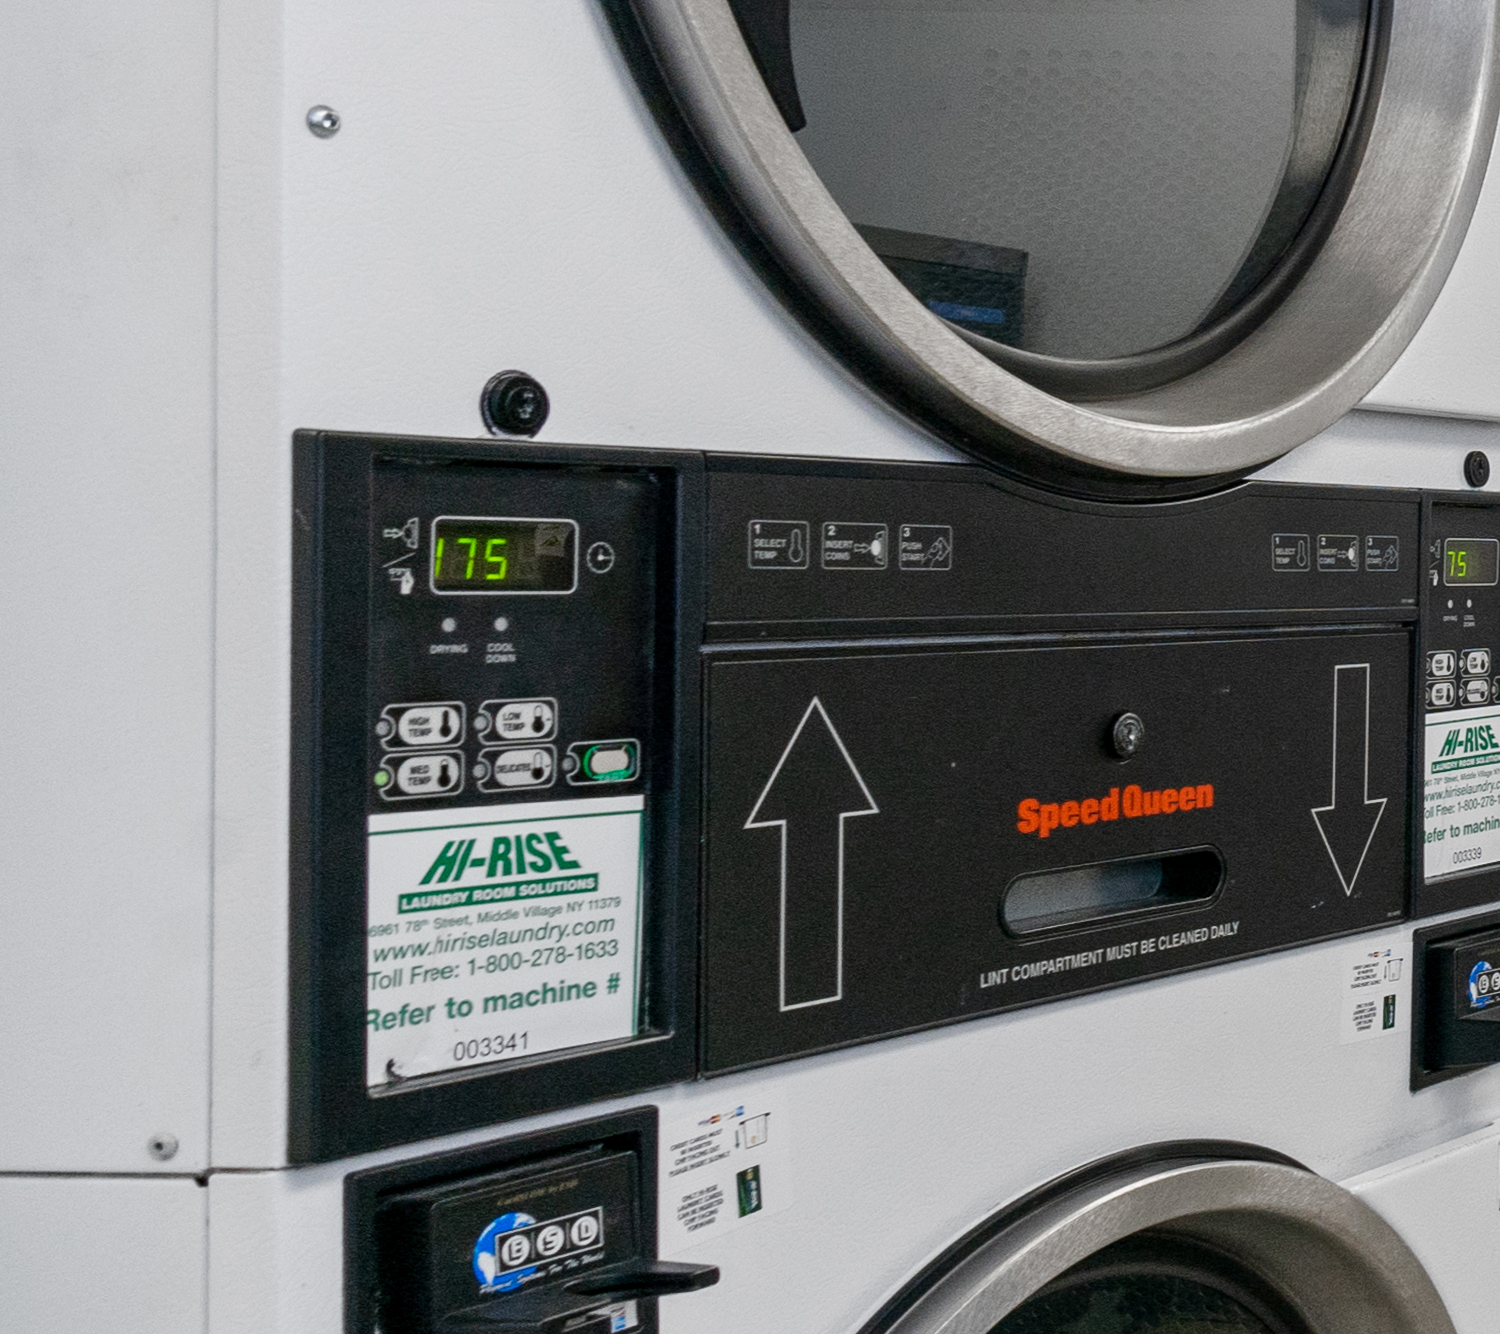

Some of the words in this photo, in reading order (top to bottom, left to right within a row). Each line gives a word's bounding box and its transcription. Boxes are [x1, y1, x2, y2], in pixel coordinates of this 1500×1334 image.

[433, 537, 508, 580] 175
[1447, 551, 1467, 577] 75
[429, 643, 468, 655] DRYING
[486, 642, 515, 653] COOL
[485, 653, 517, 664] DOWN
[407, 717, 430, 727] HIGH
[502, 711, 522, 722] LOW
[408, 727, 432, 739] TEMP
[502, 721, 526, 732] TEMP
[1438, 724, 1500, 757] HI-RISE
[407, 775, 432, 787] TEMP
[409, 765, 430, 776] MED
[1017, 786, 1121, 839] Speed
[1122, 783, 1215, 818] Queen
[418, 831, 583, 886] HI-RISE
[401, 891, 470, 910] LAUNDRY
[472, 885, 516, 903] ROOM
[518, 876, 596, 896] SOLUTIONS
[368, 923, 399, 938] 6961
[434, 914, 474, 931] Street,
[476, 909, 520, 925] Middle
[522, 903, 563, 920] Village
[566, 901, 585, 913] NY
[588, 896, 621, 910] 11379
[373, 917, 615, 963] www.hiriselaundry.com
[980, 968, 1009, 989] LINT
[1011, 948, 1104, 982] COMPARTMENT
[1106, 941, 1138, 963] MUST
[1140, 937, 1156, 954] BE
[1158, 926, 1209, 951] CLEANED
[1210, 920, 1240, 940] DAILY
[368, 969, 403, 991] Toll
[409, 962, 462, 985] Free:
[468, 938, 619, 976] 1-800-278-1633
[367, 1002, 435, 1032] Refer
[445, 997, 473, 1019] to
[483, 978, 597, 1014] machine
[606, 971, 621, 995] #
[453, 1031, 529, 1061] 003341
